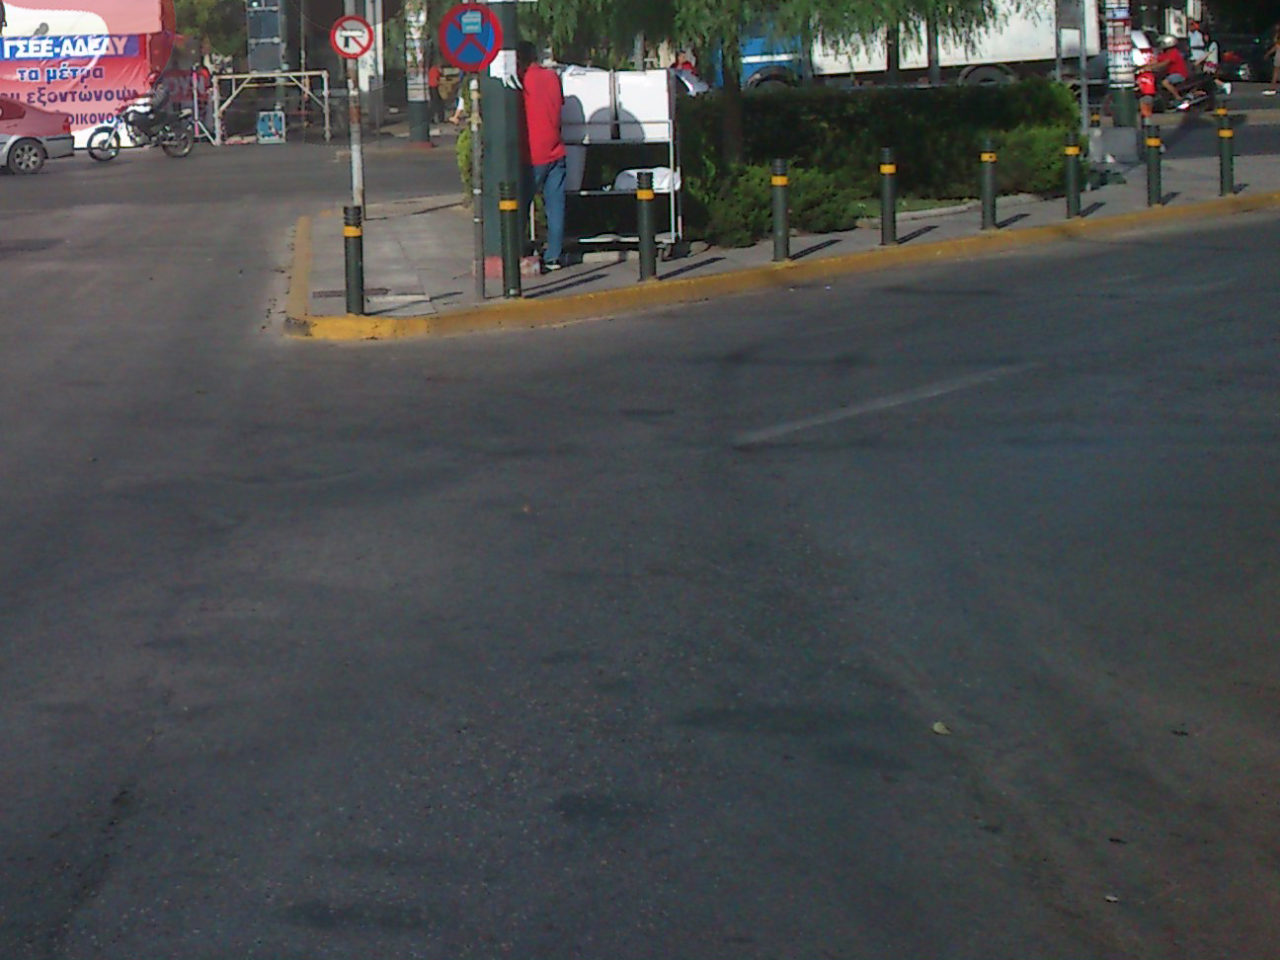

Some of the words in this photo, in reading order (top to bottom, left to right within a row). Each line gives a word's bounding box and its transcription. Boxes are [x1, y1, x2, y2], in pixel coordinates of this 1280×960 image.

[3, 36, 128, 59] ΓΣΕΕ-ΑΔΕΔΥ
[17, 68, 39, 81] τα
[46, 64, 104, 84] μέτρα
